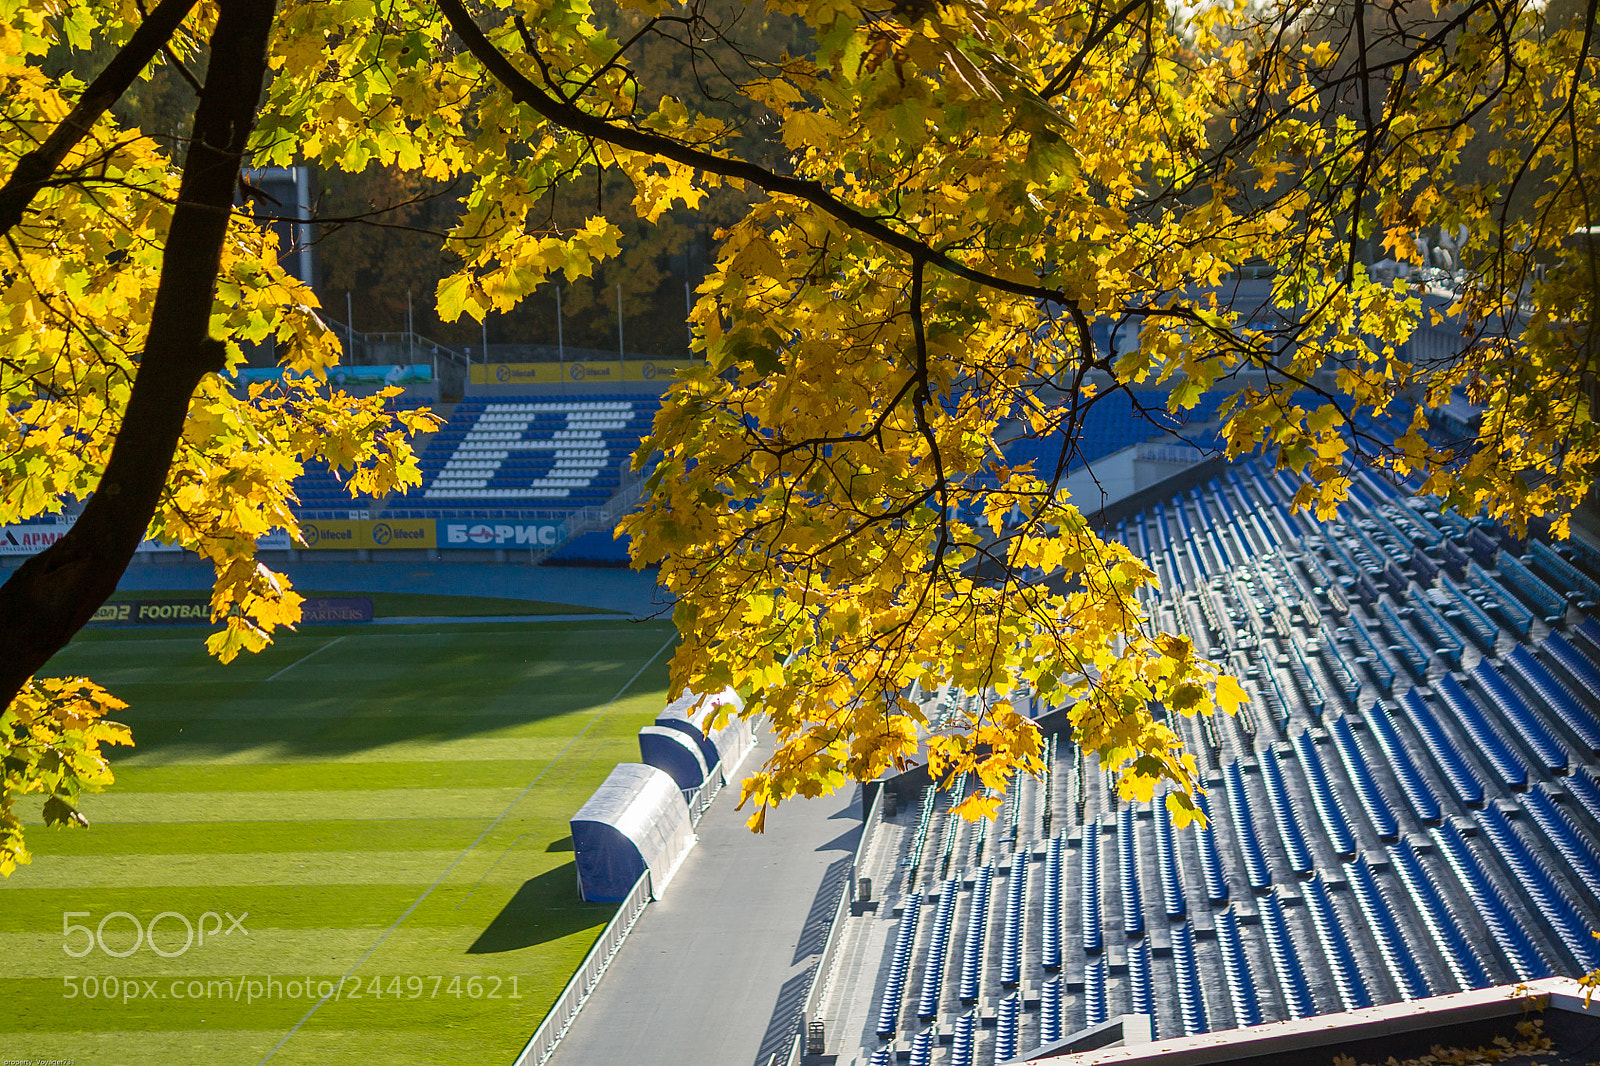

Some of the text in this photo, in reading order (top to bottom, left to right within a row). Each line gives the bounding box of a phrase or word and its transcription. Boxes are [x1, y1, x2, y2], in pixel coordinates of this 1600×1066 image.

[320, 529, 352, 540] lifecell
[393, 528, 424, 540] lifecell
[447, 524, 556, 545] БОРИС
